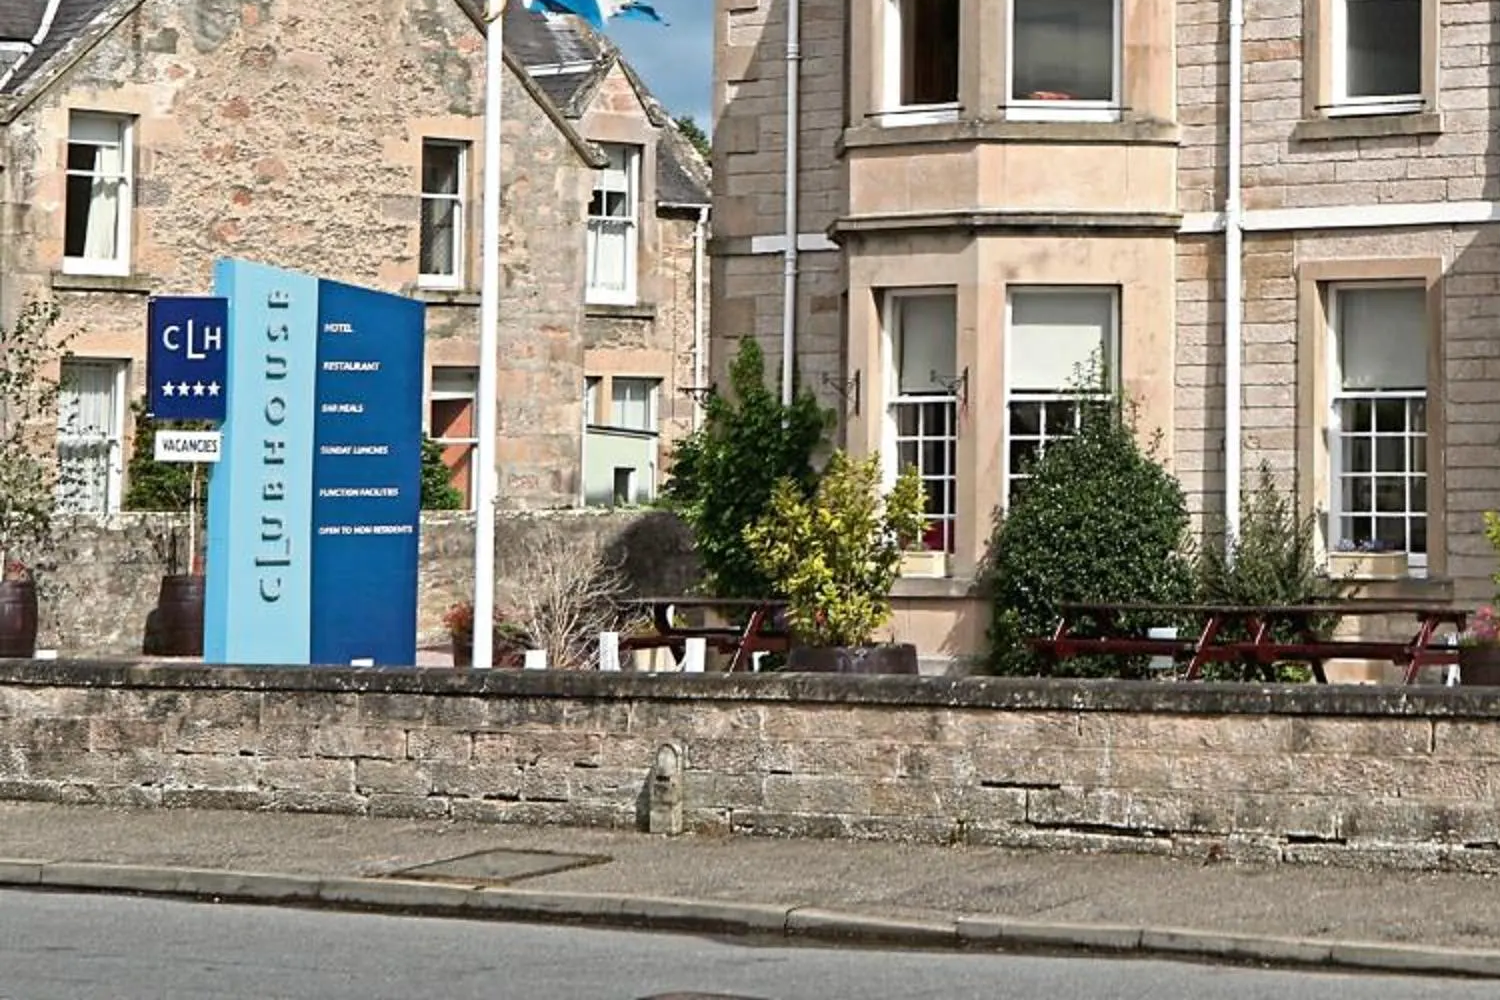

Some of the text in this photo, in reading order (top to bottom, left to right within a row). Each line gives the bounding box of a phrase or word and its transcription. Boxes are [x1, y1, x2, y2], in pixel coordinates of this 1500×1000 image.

[323, 323, 353, 333] HOTEL
[162, 319, 221, 359] CLH
[323, 361, 380, 371] RESTAURANT
[161, 438, 218, 453] VACANCIES
[255, 290, 290, 603] CLUBHOUSE
[320, 445, 351, 455] SUNDAY
[319, 487, 358, 497] FUNCTION
[318, 526, 340, 535] OPEN
[341, 526, 352, 535] TO
